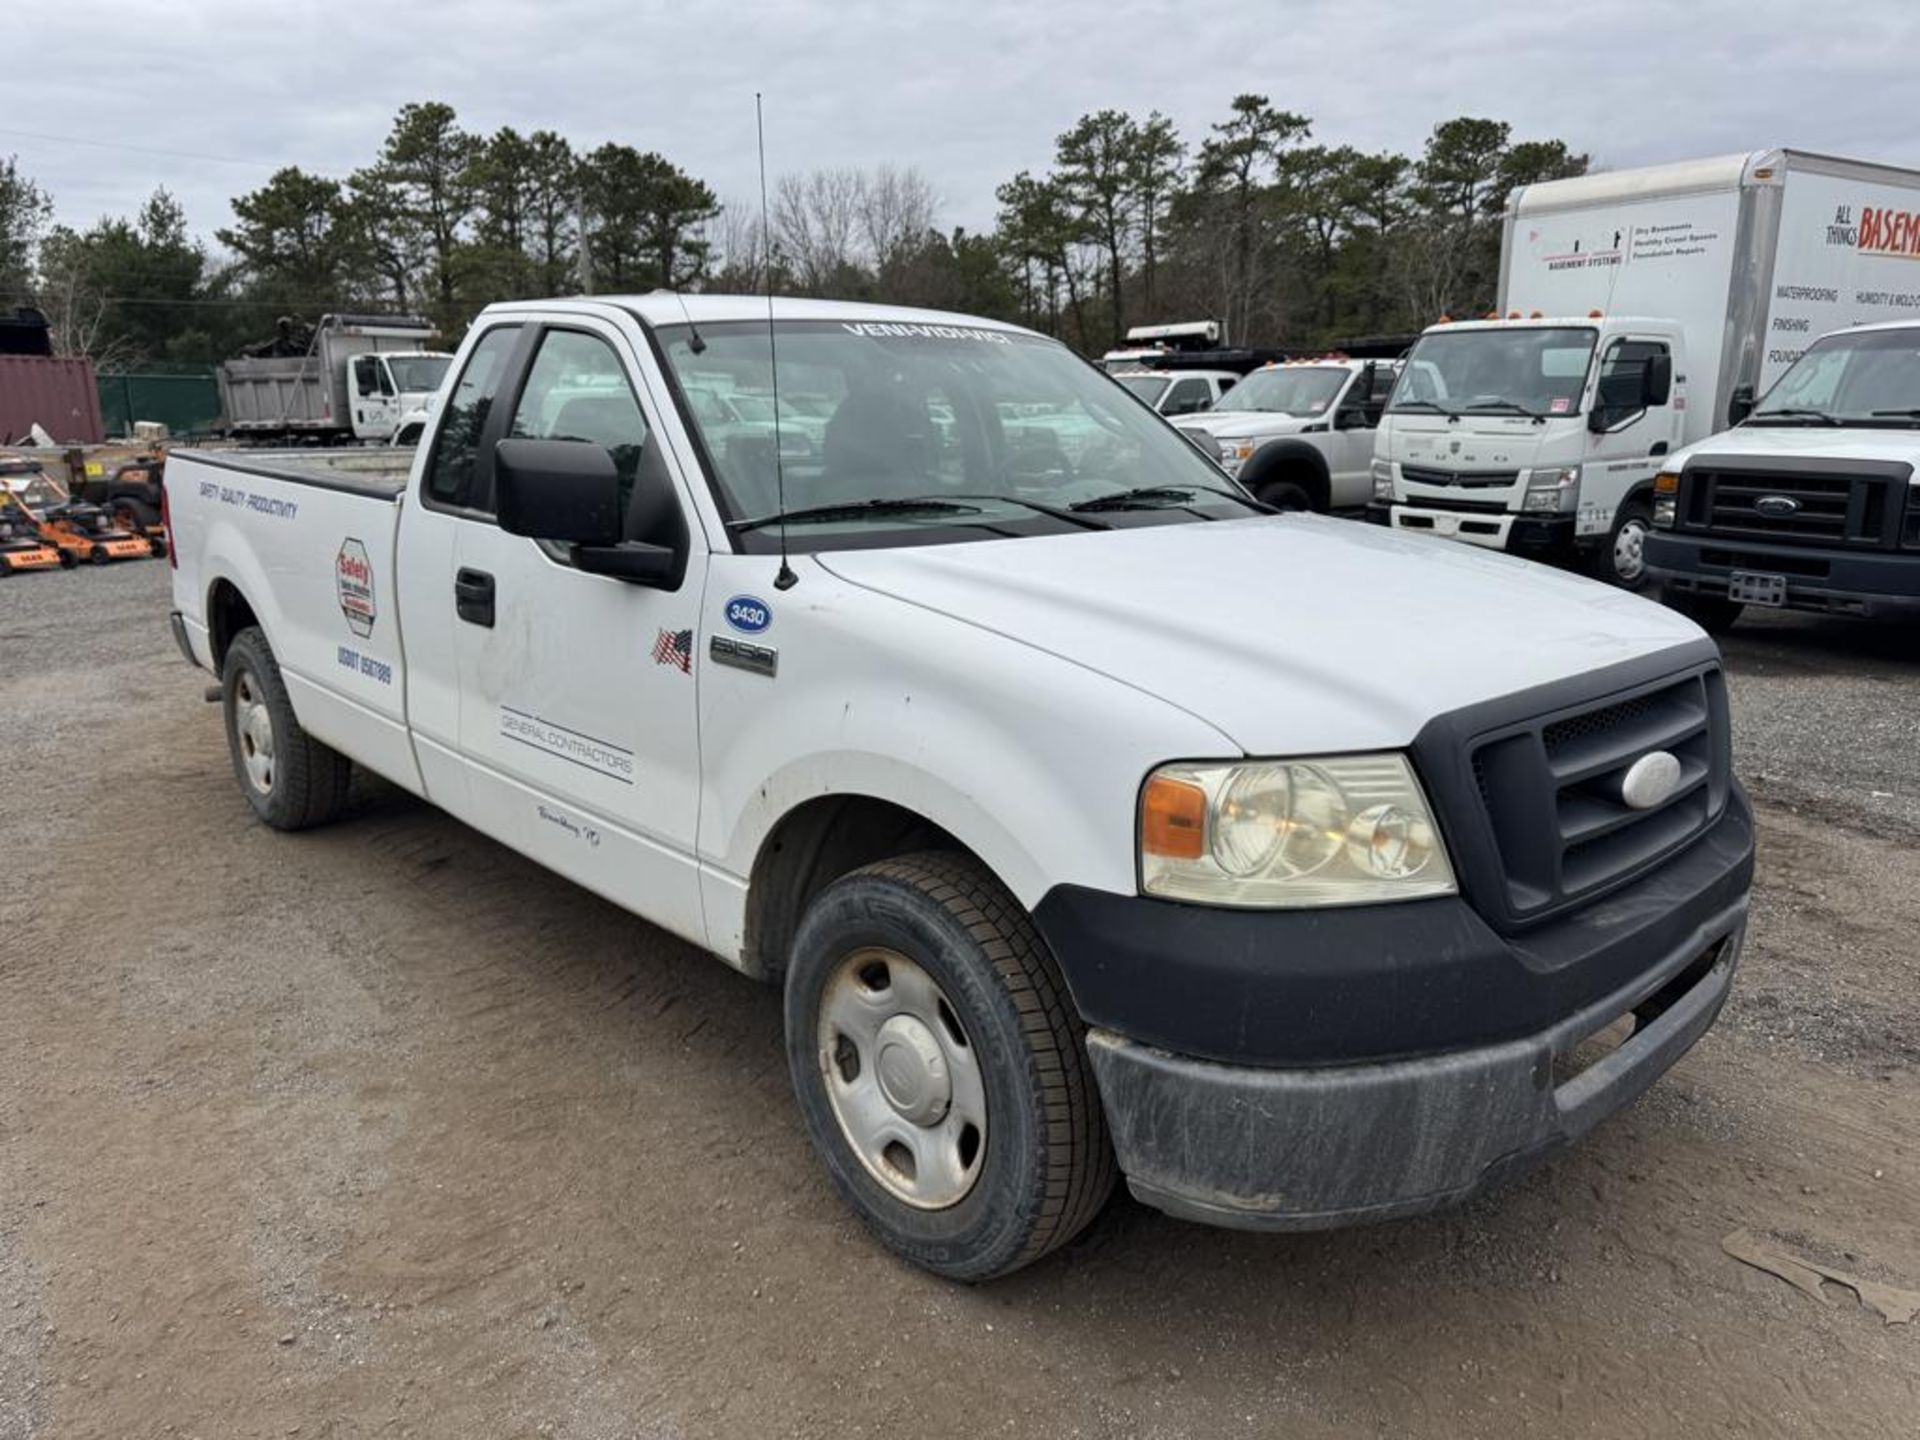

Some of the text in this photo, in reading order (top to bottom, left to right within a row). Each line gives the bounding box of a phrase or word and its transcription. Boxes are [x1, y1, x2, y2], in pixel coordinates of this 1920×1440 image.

[1834, 204, 1851, 224] ALL
[1826, 206, 1920, 254] THINGS BASEM
[1588, 255, 1622, 267] SYSTEMS
[1776, 285, 1838, 302] WATERPROOFING
[1772, 317, 1809, 332] FINISHING
[1768, 349, 1806, 363] FOUNDA
[340, 552, 368, 585] Safety
[729, 603, 765, 626] 3430
[502, 714, 633, 774] GENERAL CONTRACTORS
